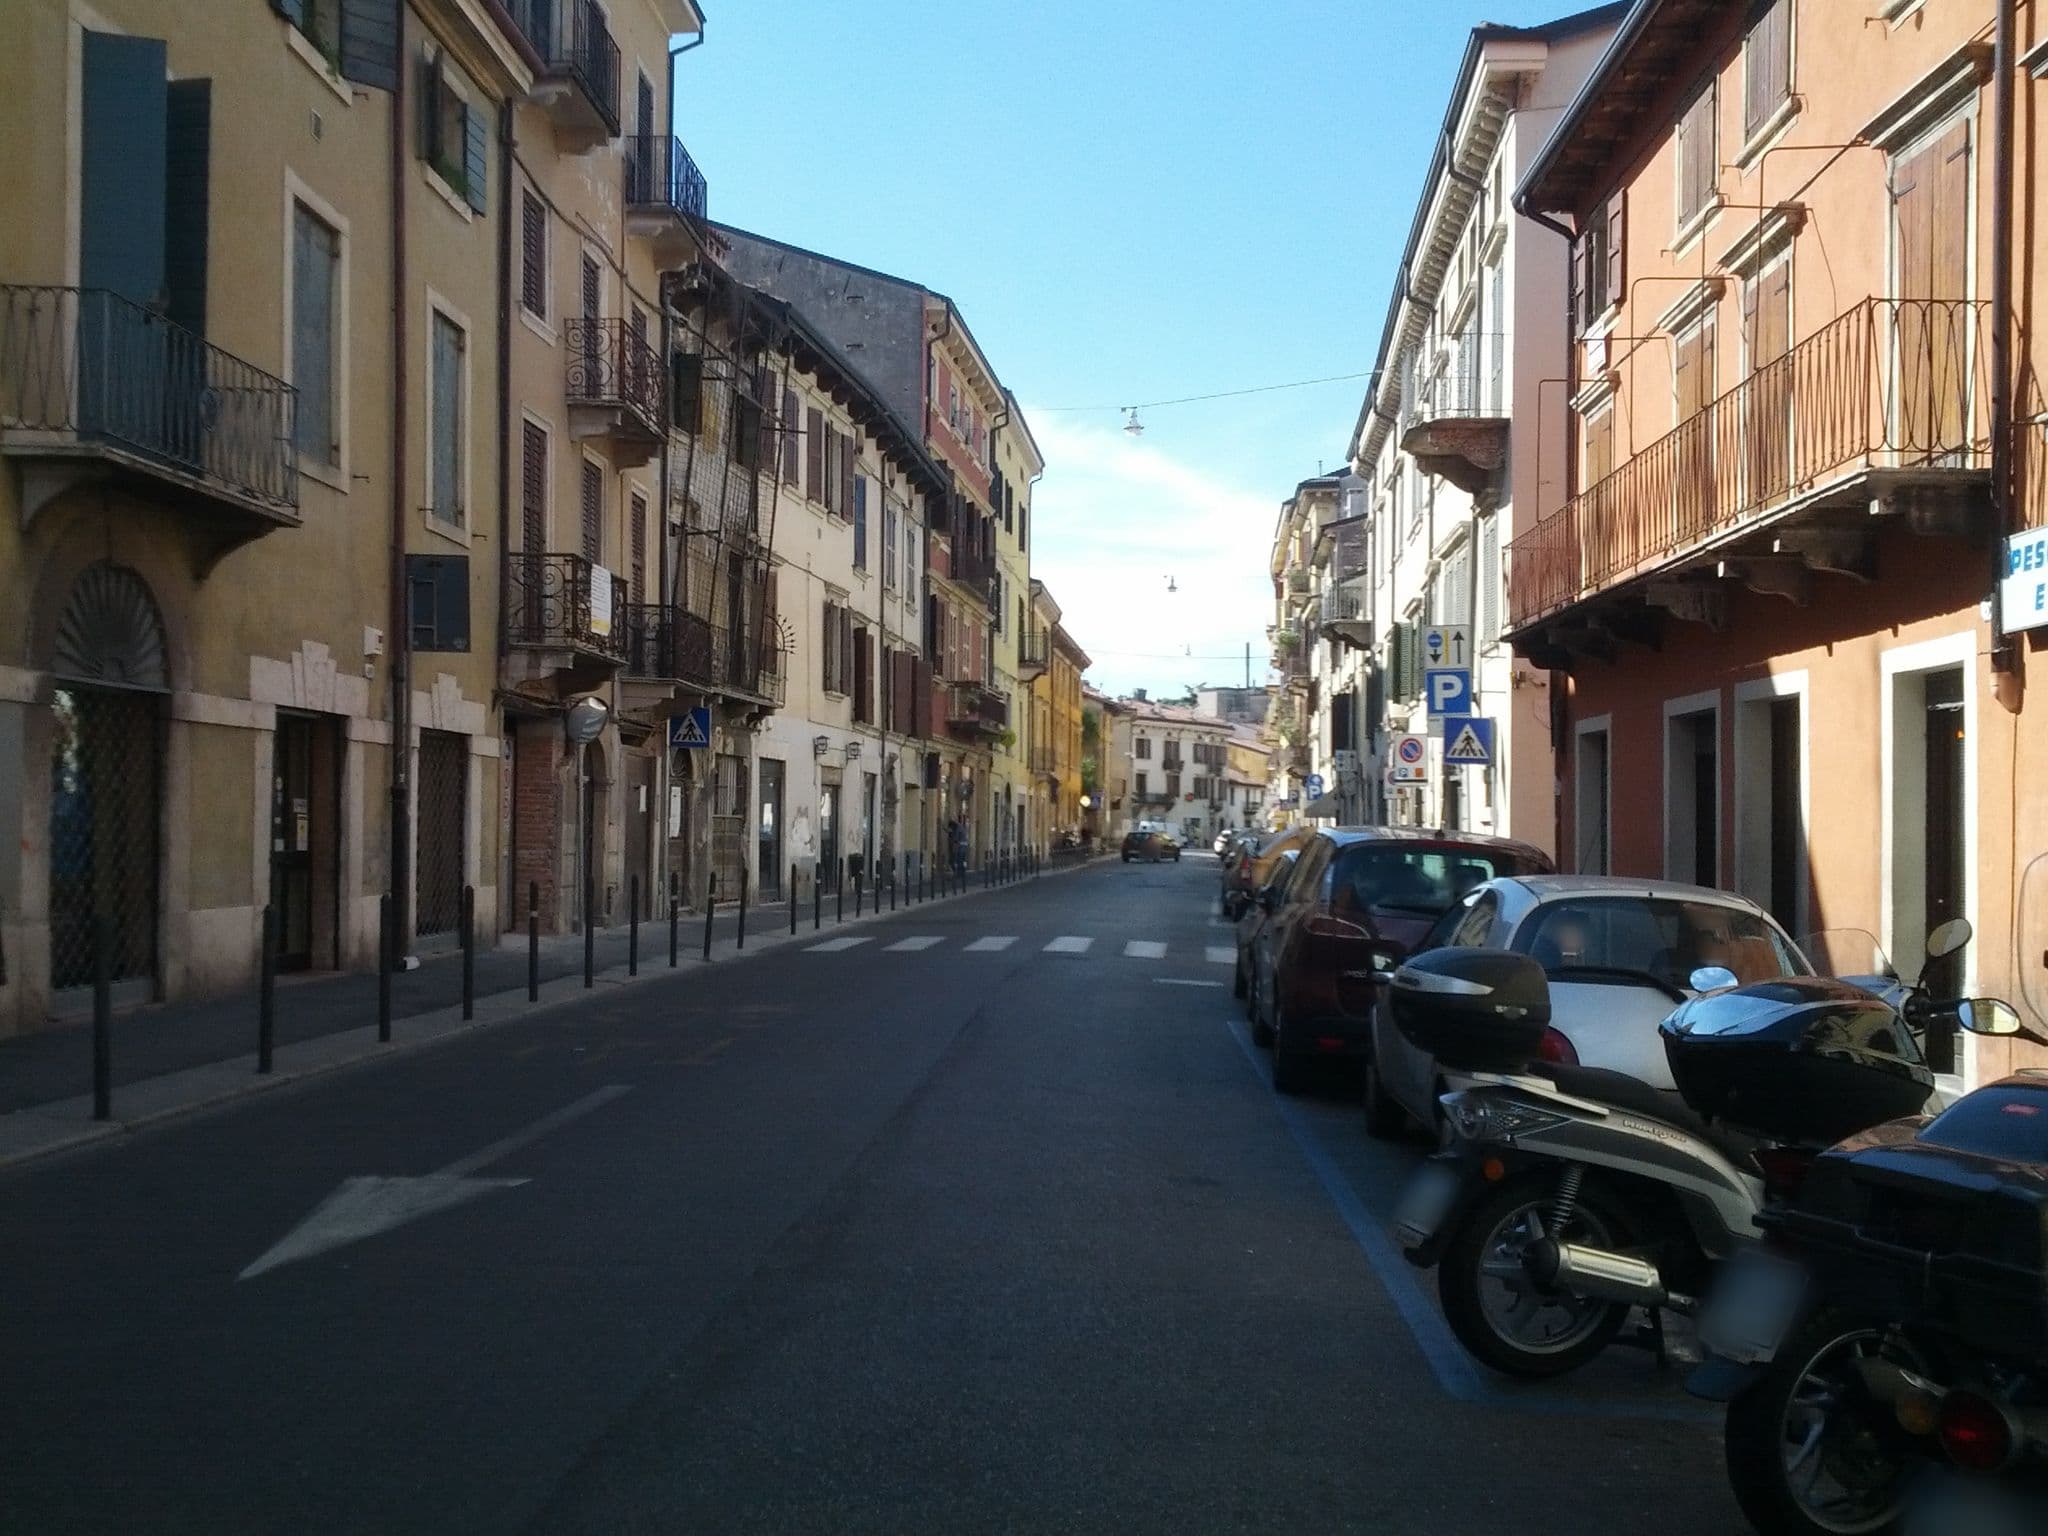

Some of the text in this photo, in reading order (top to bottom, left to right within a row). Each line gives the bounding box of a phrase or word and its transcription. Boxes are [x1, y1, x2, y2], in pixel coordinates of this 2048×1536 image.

[2008, 540, 2048, 575] PES
[1434, 675, 1463, 710] P
[1309, 785, 1321, 799] P
